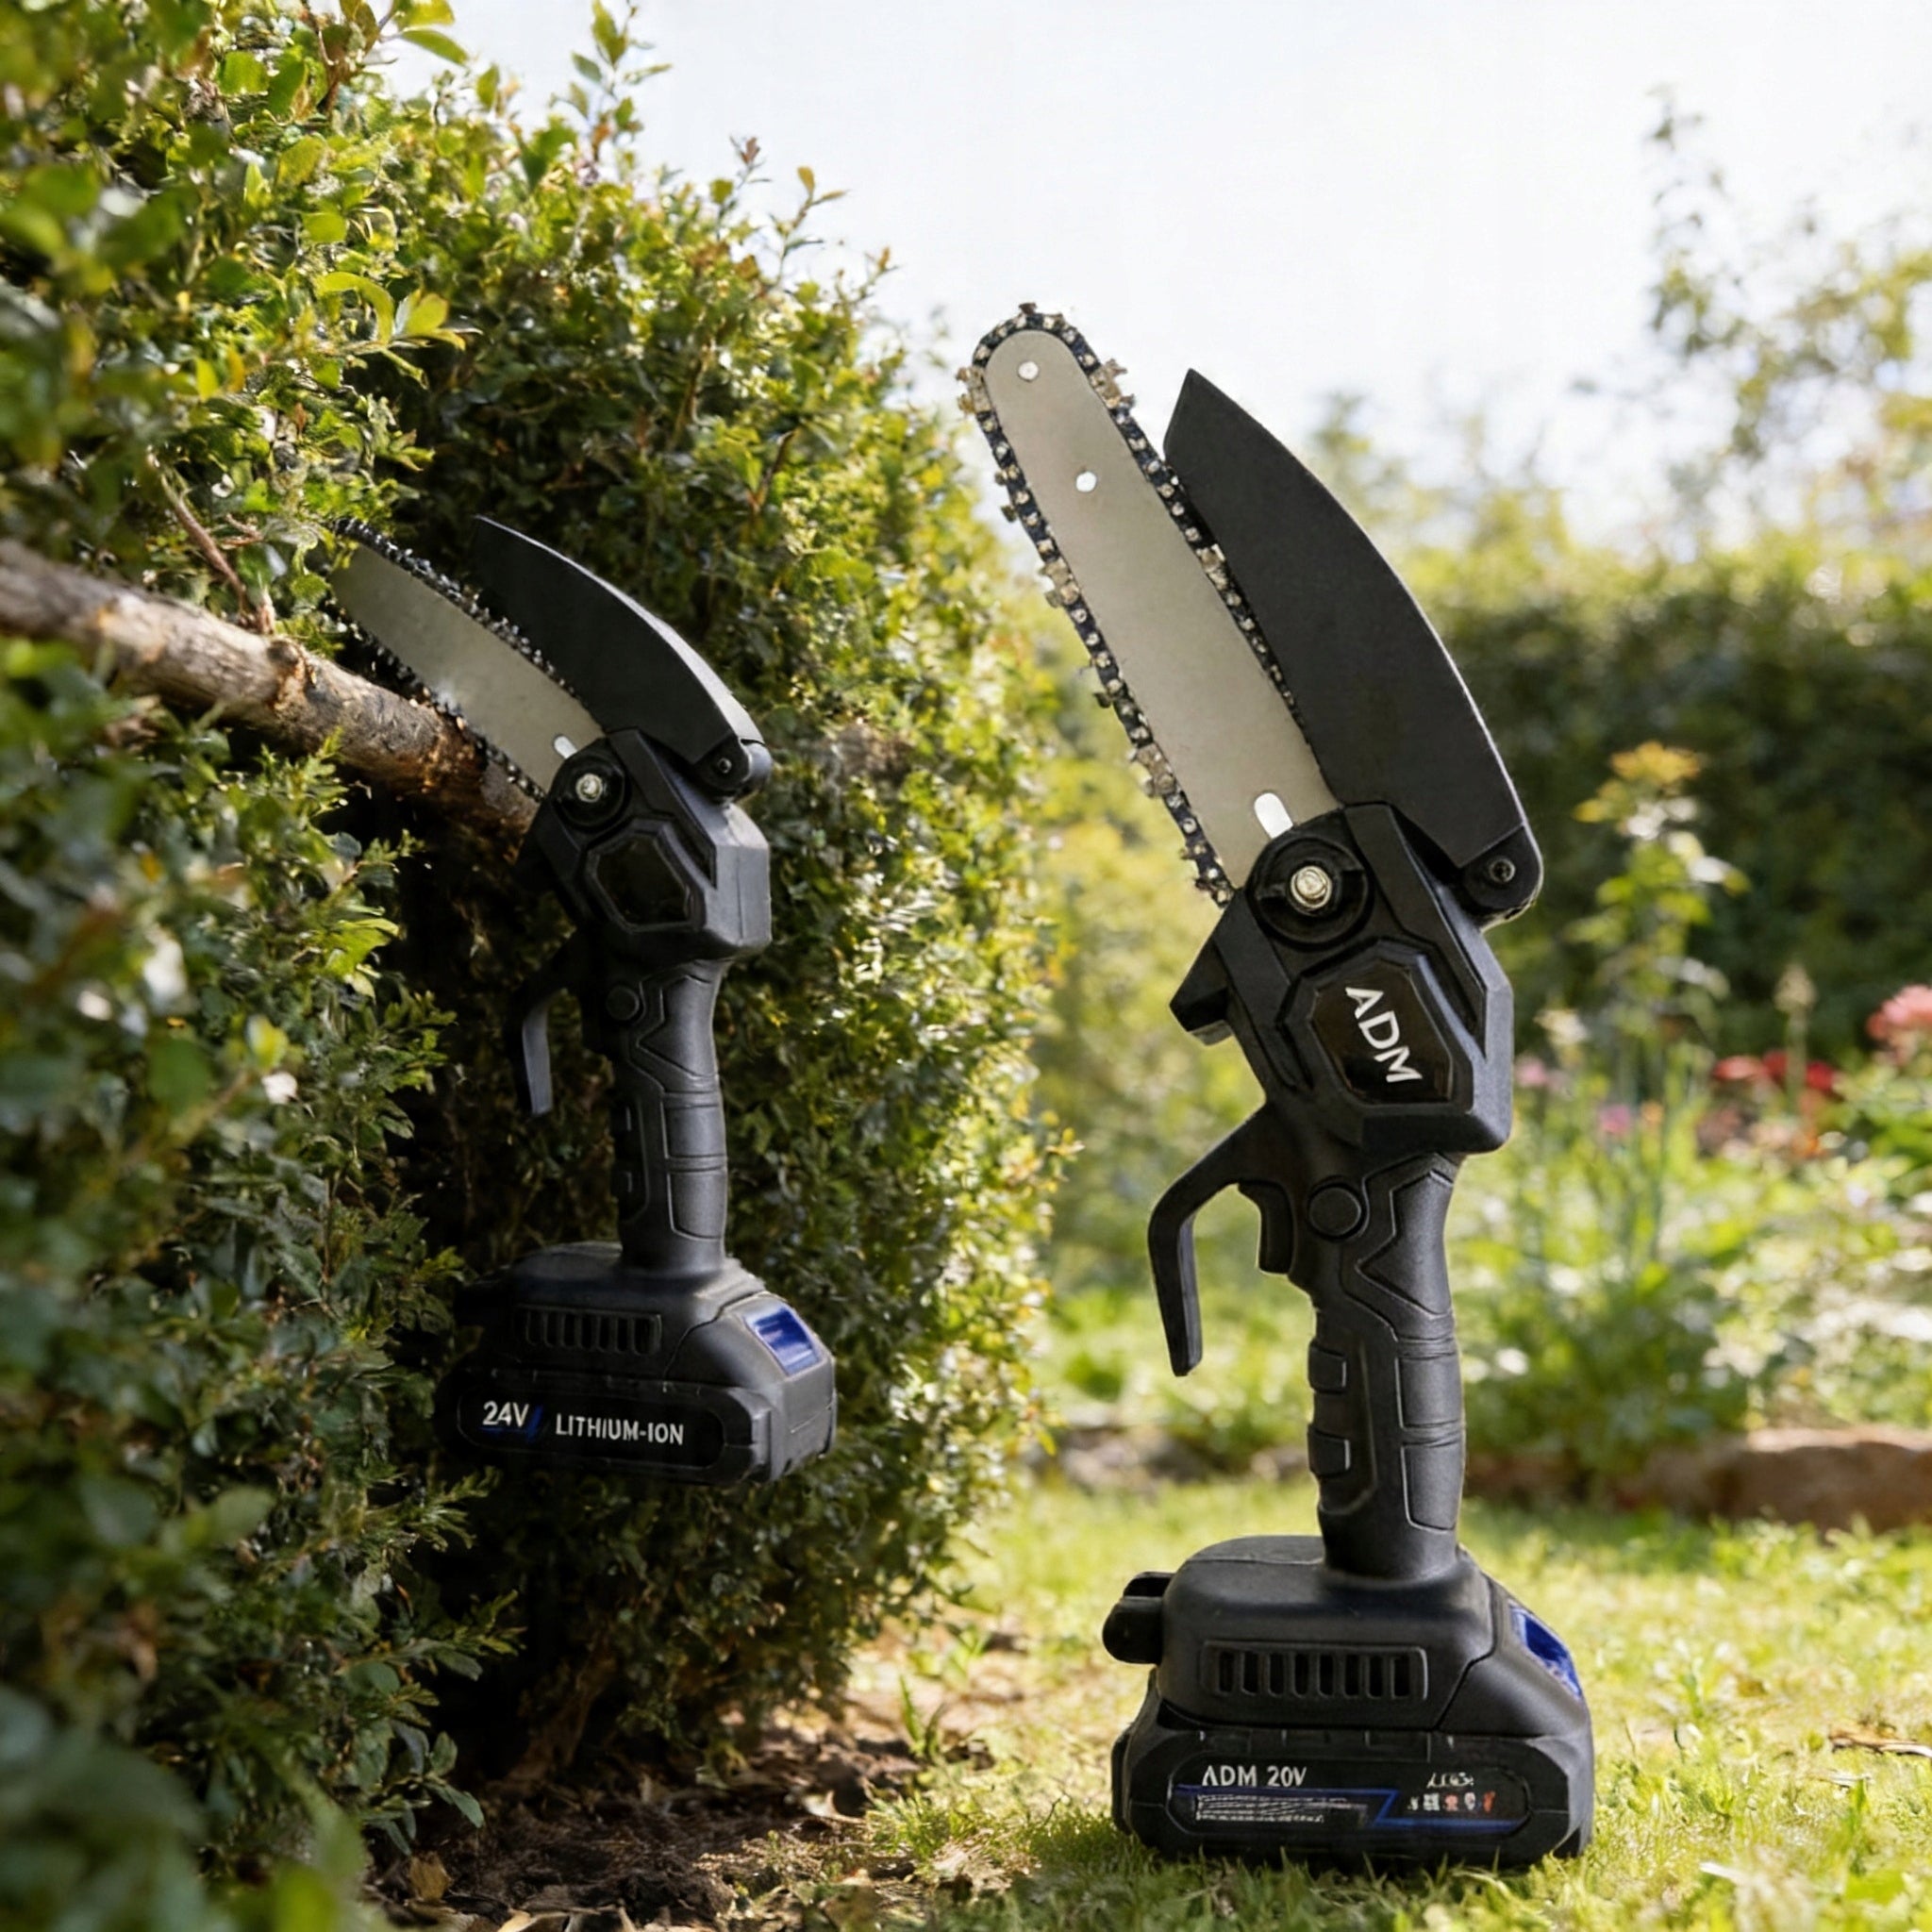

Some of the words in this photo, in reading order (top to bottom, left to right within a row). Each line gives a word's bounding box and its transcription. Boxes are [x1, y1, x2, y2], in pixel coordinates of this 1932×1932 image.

[1345, 987, 1423, 1083] ADM
[482, 1401, 529, 1427] 24V
[555, 1413, 684, 1446] LITHIUM-ION
[1201, 1765, 1257, 1788] ADM
[1267, 1766, 1307, 1788] 20V
